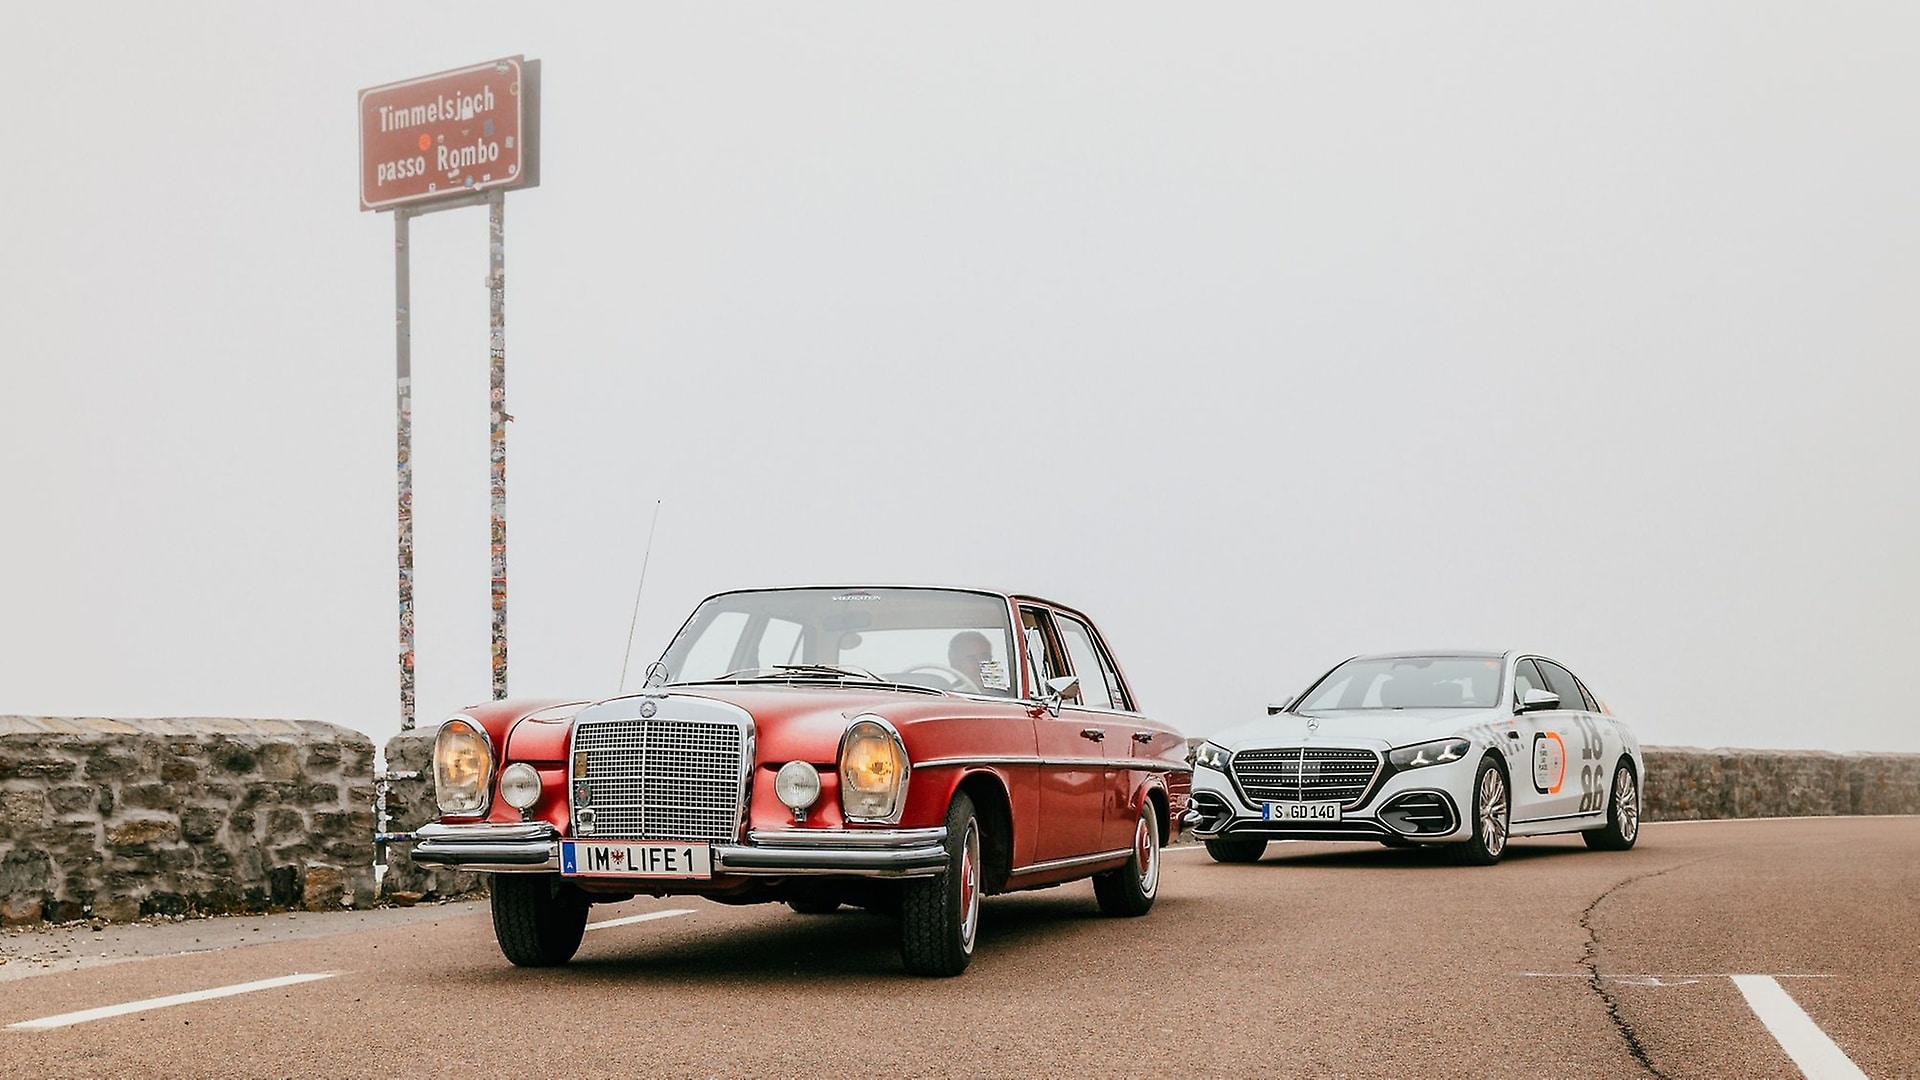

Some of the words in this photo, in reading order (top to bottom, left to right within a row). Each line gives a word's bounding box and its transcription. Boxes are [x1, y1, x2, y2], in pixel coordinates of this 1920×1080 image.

[380, 85, 494, 132] Timmelsjoch
[378, 156, 425, 186] passo
[438, 138, 498, 171] Rombo
[1573, 715, 1603, 760] 18
[1579, 764, 1604, 812] 86
[1275, 805, 1283, 819] S
[1291, 805, 1308, 819] GD
[1310, 805, 1335, 819] 140
[566, 861, 574, 869] A
[587, 847, 610, 871] IM
[627, 847, 678, 872] LIFE
[683, 848, 694, 872] 1
